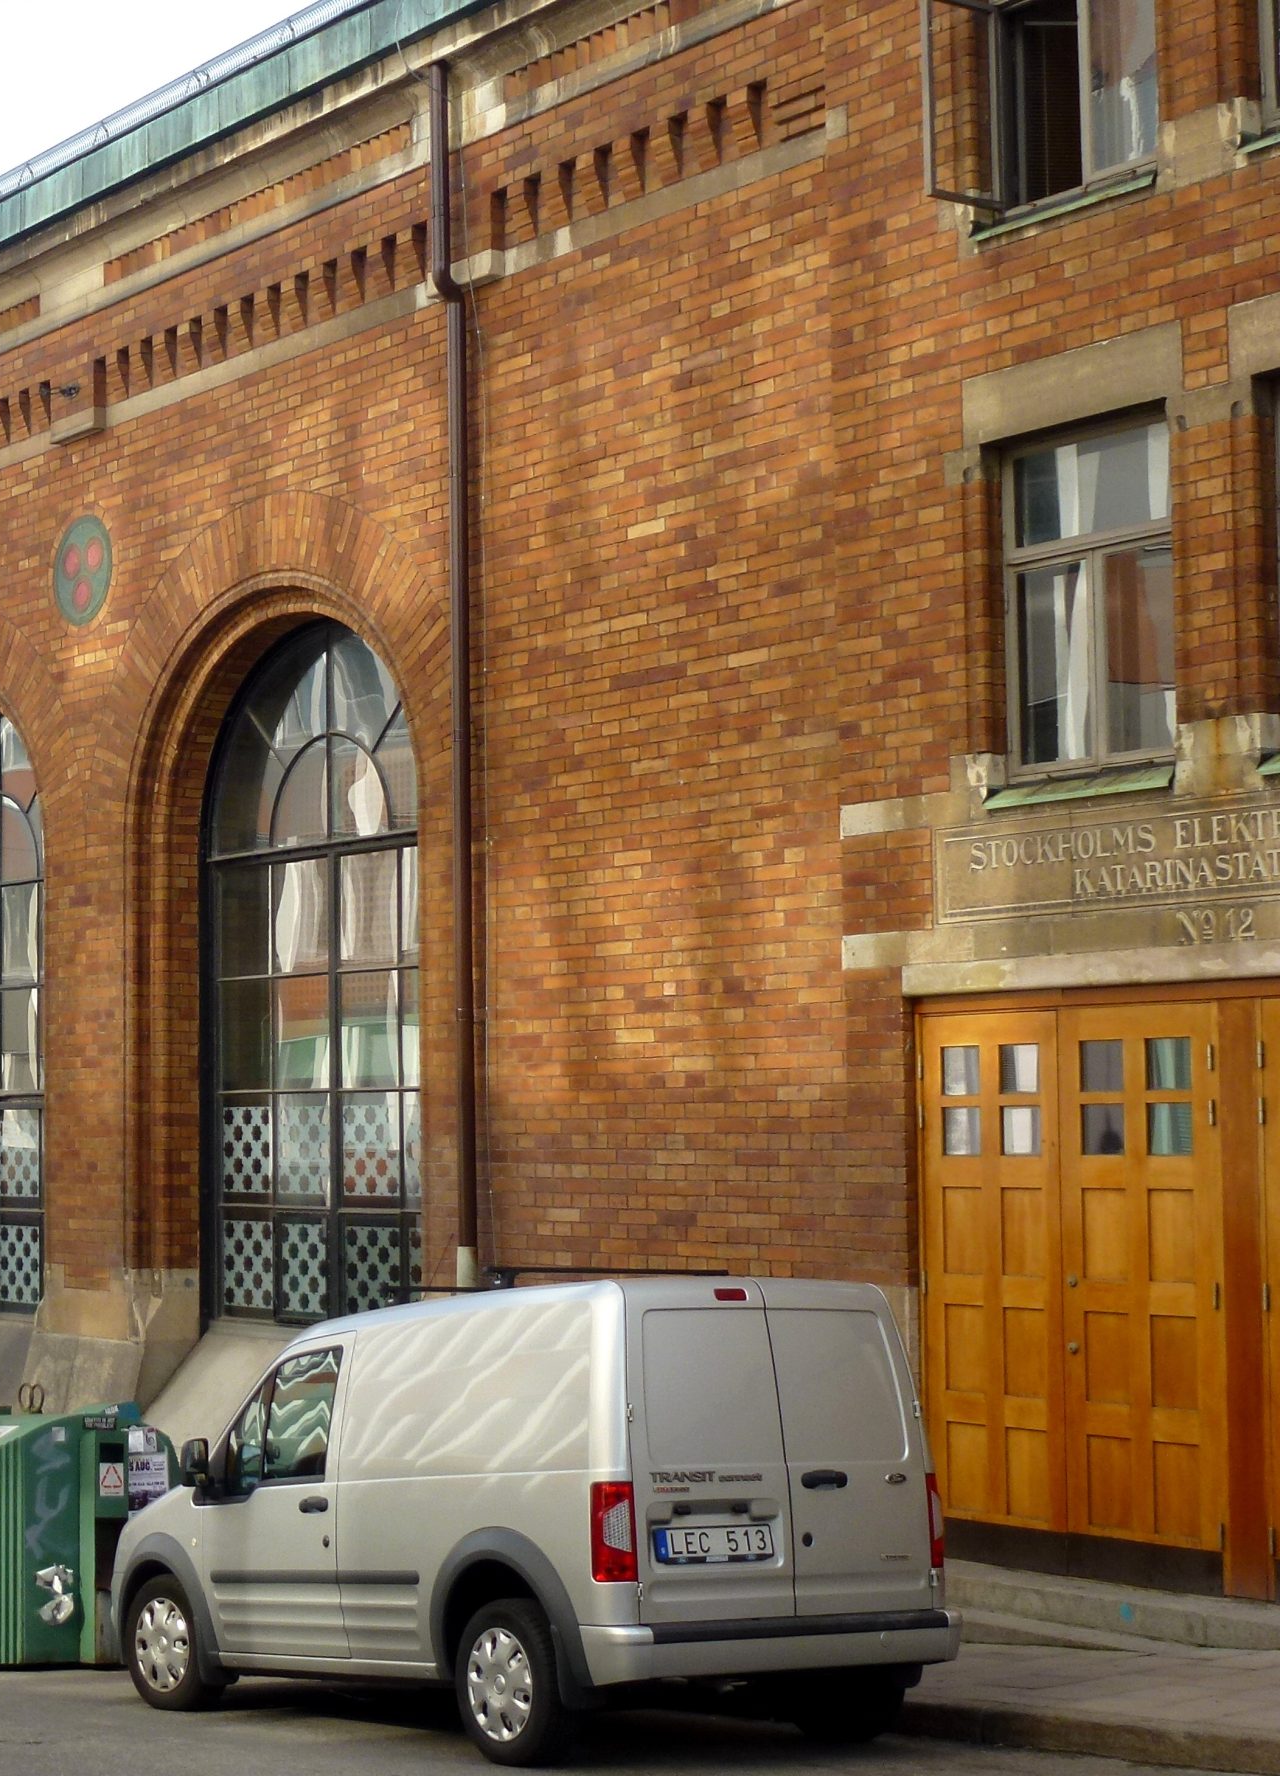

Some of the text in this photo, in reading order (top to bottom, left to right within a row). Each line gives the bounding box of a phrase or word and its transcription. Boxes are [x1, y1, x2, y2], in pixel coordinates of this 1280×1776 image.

[970, 823, 1156, 871] STOCKHOLMS
[1225, 907, 1256, 940] 12
[649, 1470, 716, 1483] TRANSIT
[670, 1528, 767, 1555] LEC 513
